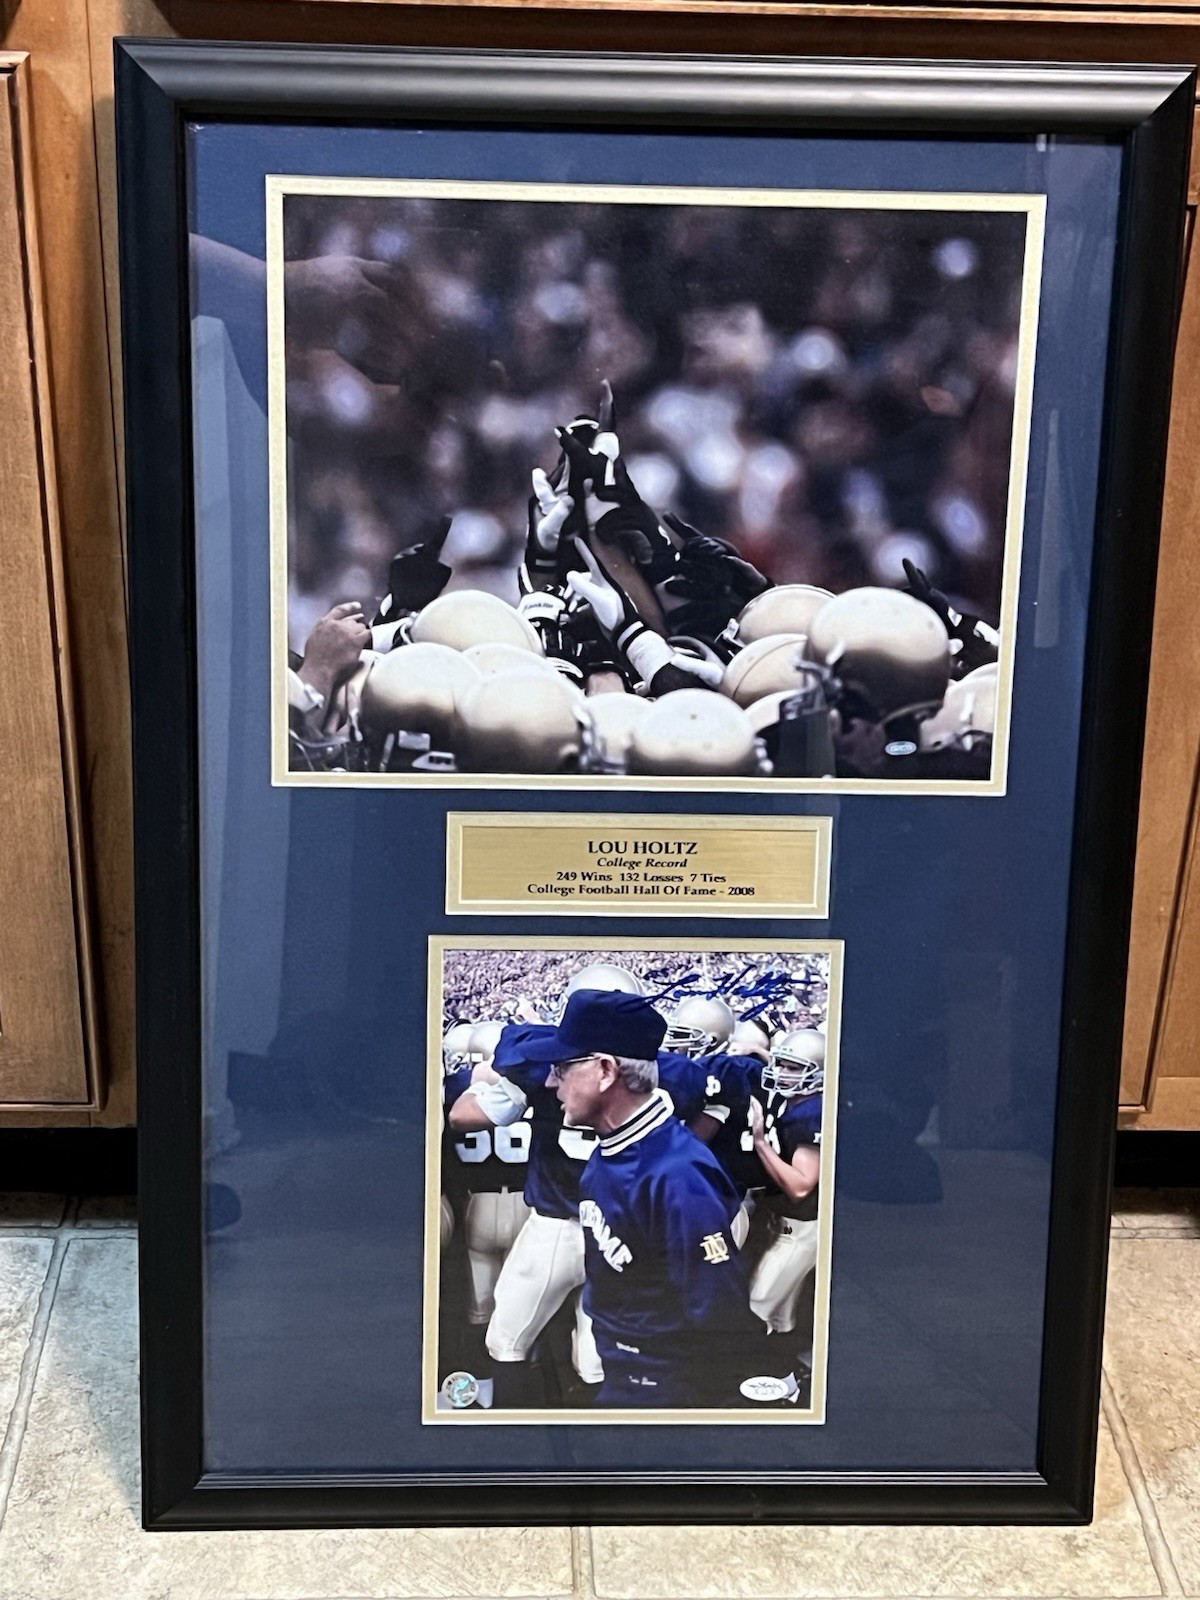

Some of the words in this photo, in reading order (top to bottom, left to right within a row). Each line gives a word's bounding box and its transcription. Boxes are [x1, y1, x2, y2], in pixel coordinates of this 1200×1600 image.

[588, 840, 628, 854] LOU
[633, 841, 698, 855] HOLTZ
[597, 857, 642, 870] College
[645, 858, 688, 868] Record
[556, 871, 577, 881] 249
[581, 872, 612, 881] Wins
[620, 873, 640, 882] 132
[643, 873, 684, 882] Losses
[690, 873, 698, 883] 7
[700, 873, 727, 883] Ties
[527, 883, 575, 897] College
[578, 884, 629, 894] Football
[633, 885, 660, 895] Hall
[663, 885, 680, 895] Of
[683, 886, 717, 895] Fame
[727, 887, 755, 896] 2008
